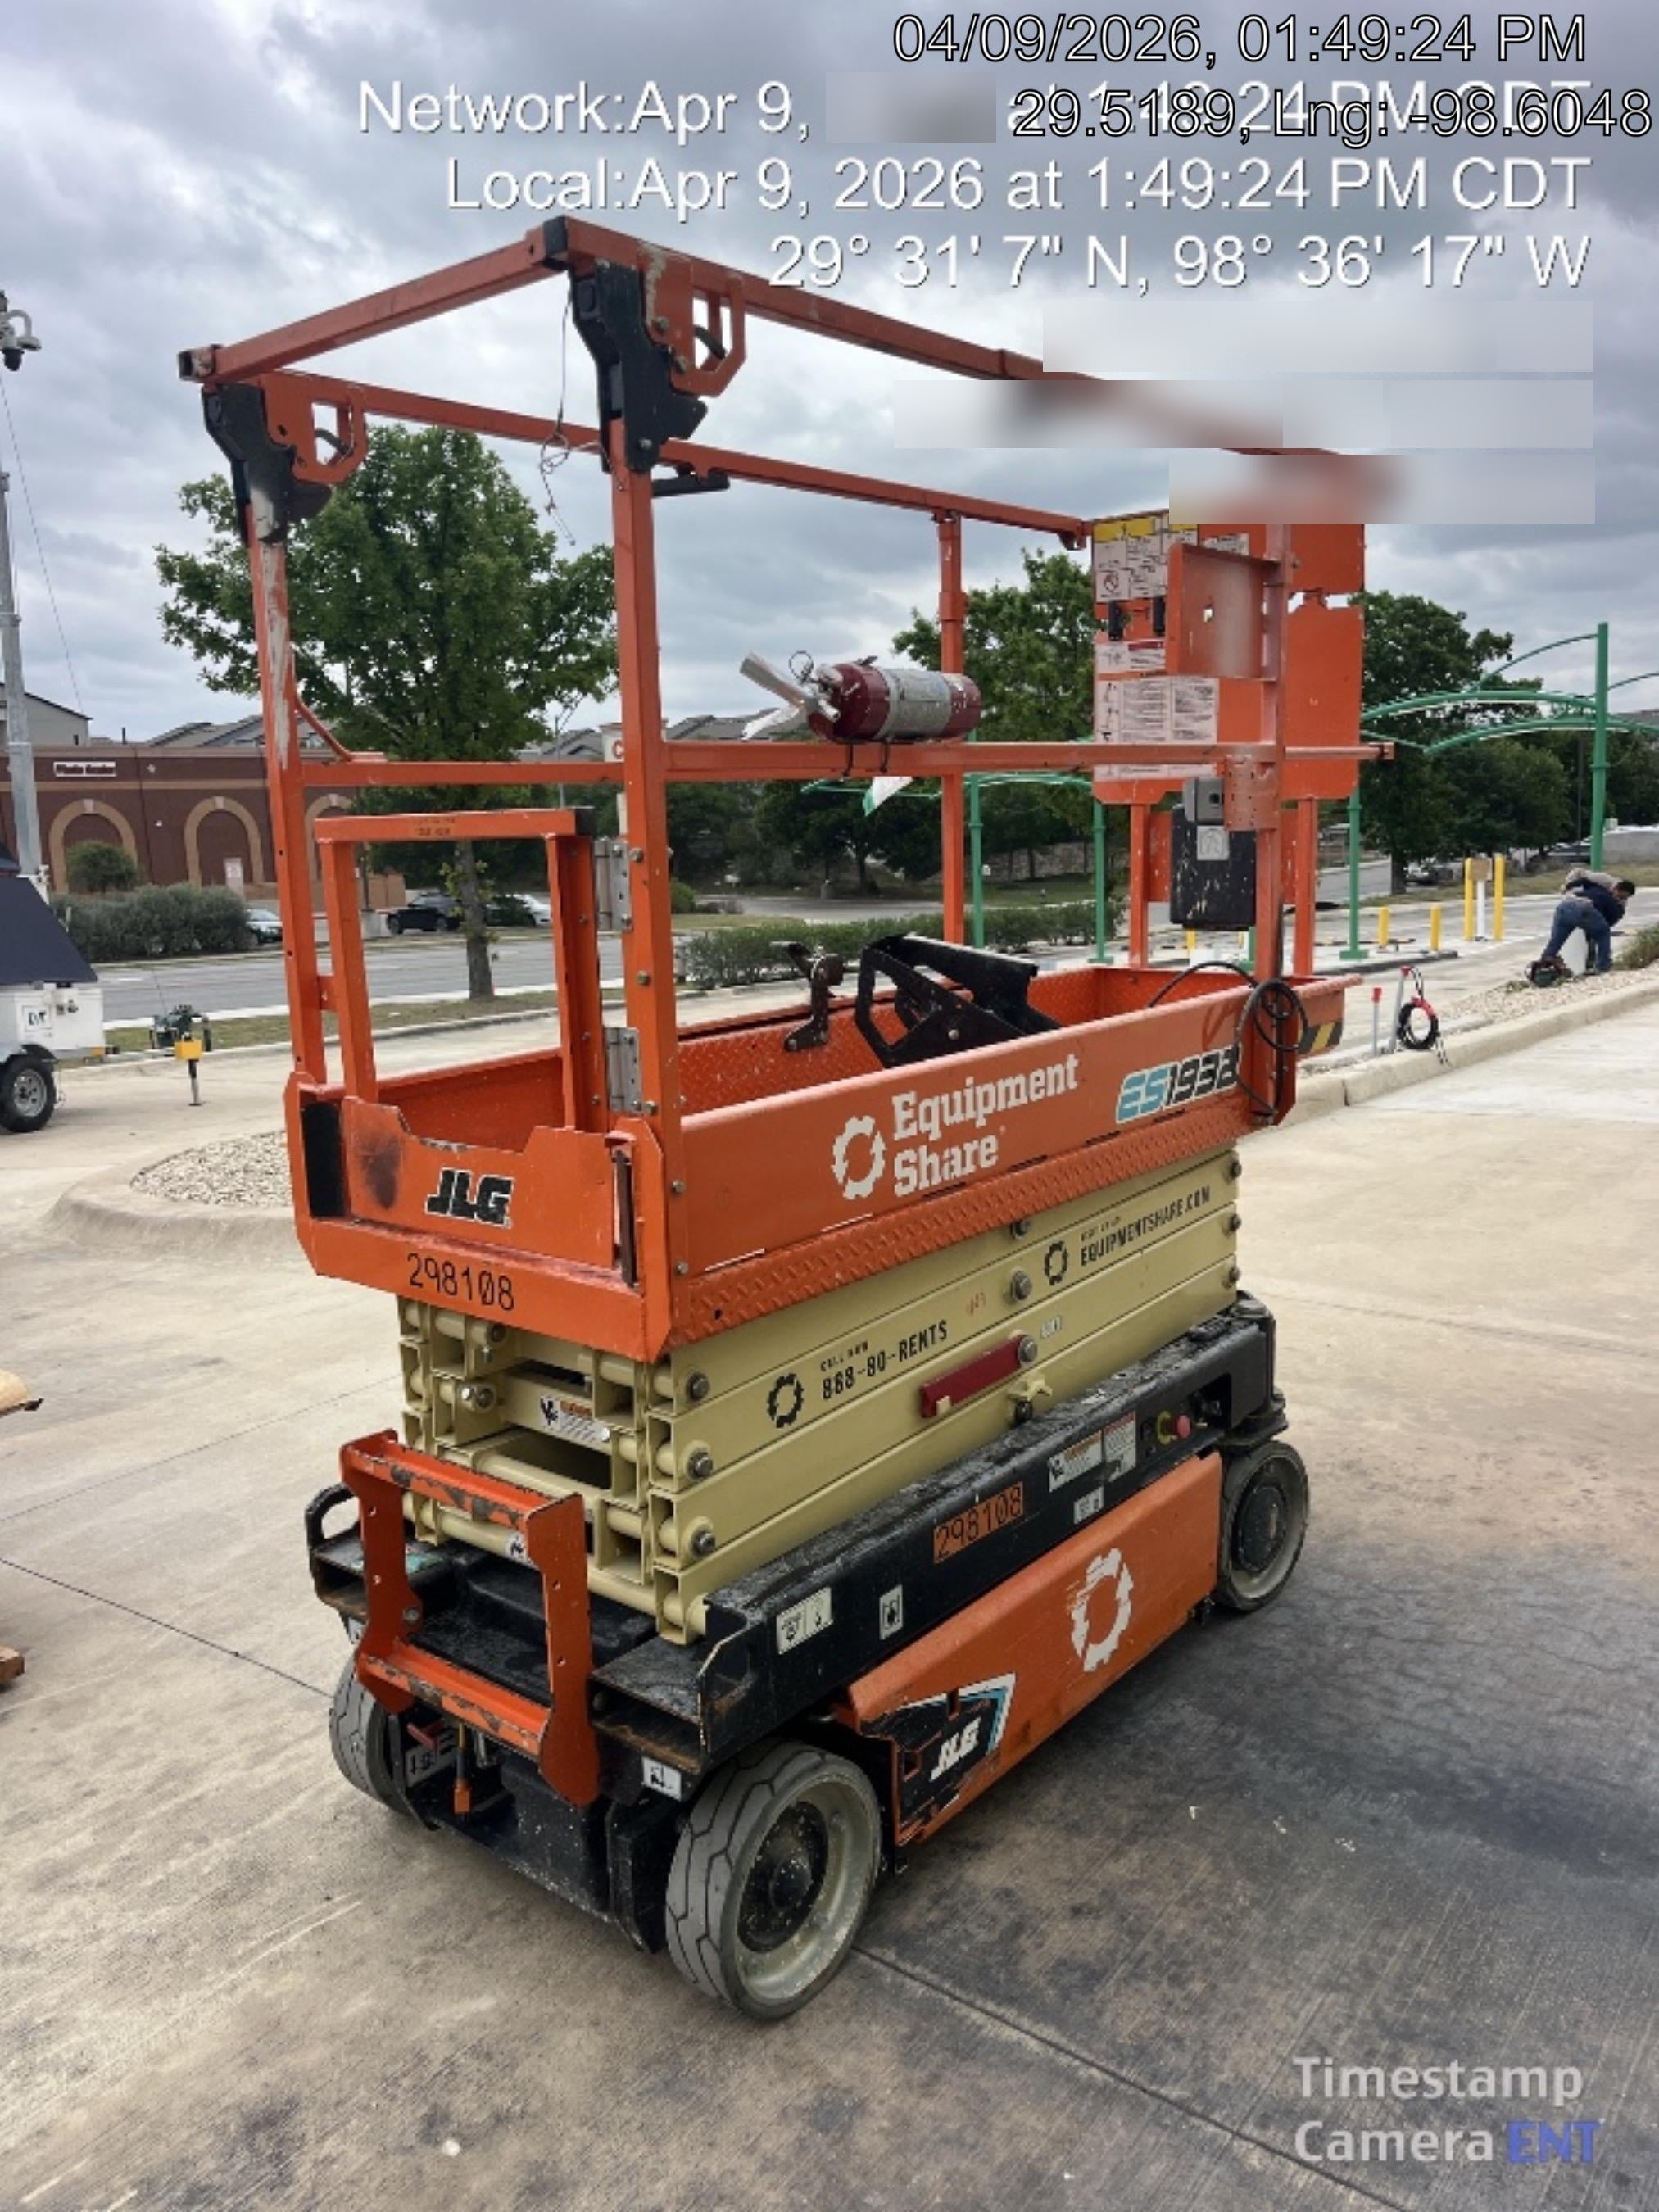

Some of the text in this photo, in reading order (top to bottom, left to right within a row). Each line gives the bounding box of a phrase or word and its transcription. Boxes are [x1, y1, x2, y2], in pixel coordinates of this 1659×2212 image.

[891, 1054, 1079, 1141] Equipment
[424, 1167, 516, 1229] JLG
[894, 1135, 999, 1197] Share
[407, 1253, 514, 1311] 298108
[822, 1320, 948, 1399] 888-80-RENTS
[936, 1486, 1022, 1560] 298108
[929, 1716, 982, 1784] JLG
